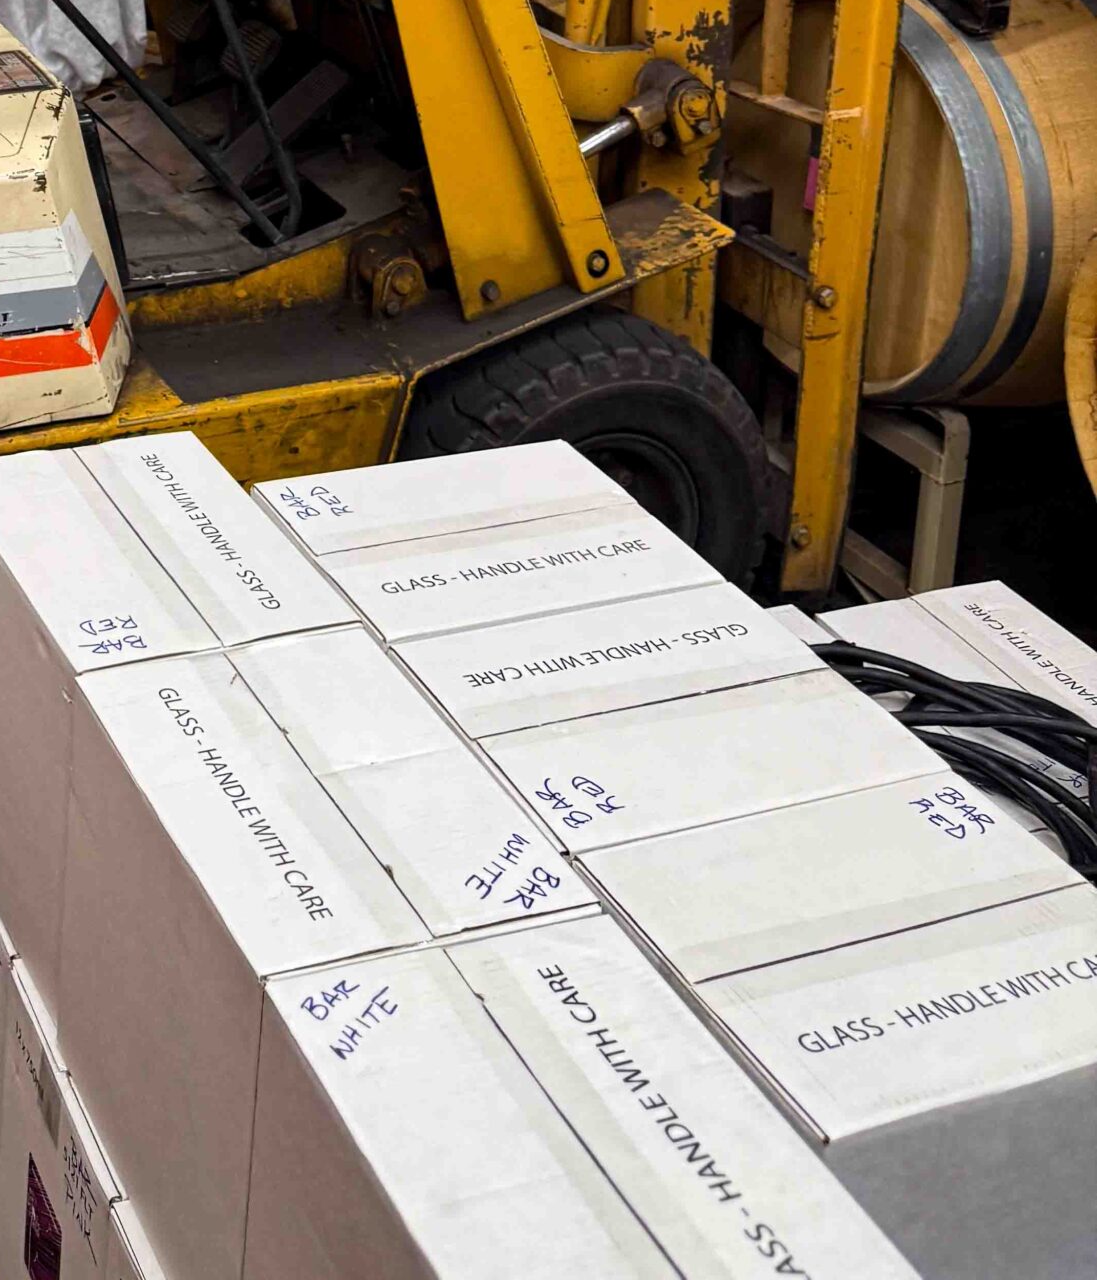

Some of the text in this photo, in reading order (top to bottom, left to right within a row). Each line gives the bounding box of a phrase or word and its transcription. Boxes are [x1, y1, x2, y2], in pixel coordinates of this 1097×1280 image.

[140, 453, 174, 481] CARE
[164, 482, 199, 513] WITH
[280, 486, 321, 520] BAR
[310, 486, 355, 517] RED
[188, 512, 242, 561] HANDLE
[381, 573, 448, 595] GLASS
[459, 557, 543, 581] HANDLE
[540, 548, 598, 568] WITH
[597, 539, 652, 558] CARE
[237, 569, 280, 610] GLASS
[77, 635, 148, 654] BAR
[79, 615, 138, 636] RED
[681, 623, 749, 646] GLASS
[523, 655, 583, 677] WITH
[580, 637, 672, 665] HANDLE
[964, 603, 1097, 706] HANDLE WITH CARE
[462, 667, 523, 688] CARE
[158, 687, 204, 737] GLASS
[198, 748, 261, 819] HANDLE
[248, 818, 296, 867] WITH
[284, 870, 334, 922] CARE
[535, 777, 593, 829] BAR
[571, 775, 626, 814] RED
[934, 786, 996, 835] BAR
[908, 797, 966, 839] RED
[464, 833, 531, 900] WHITE
[503, 866, 561, 910] BAR
[300, 979, 361, 1021] BAR
[536, 963, 597, 1024] CARE
[797, 1016, 885, 1054] GLASS
[895, 984, 1007, 1029] HANDLE
[997, 966, 1072, 1000] WITH
[1066, 955, 1097, 980] CA
[329, 985, 399, 1061] WHITE
[587, 1027, 650, 1093] WITH
[638, 1092, 742, 1203] HANDLE
[744, 1222, 812, 1280] ASS
